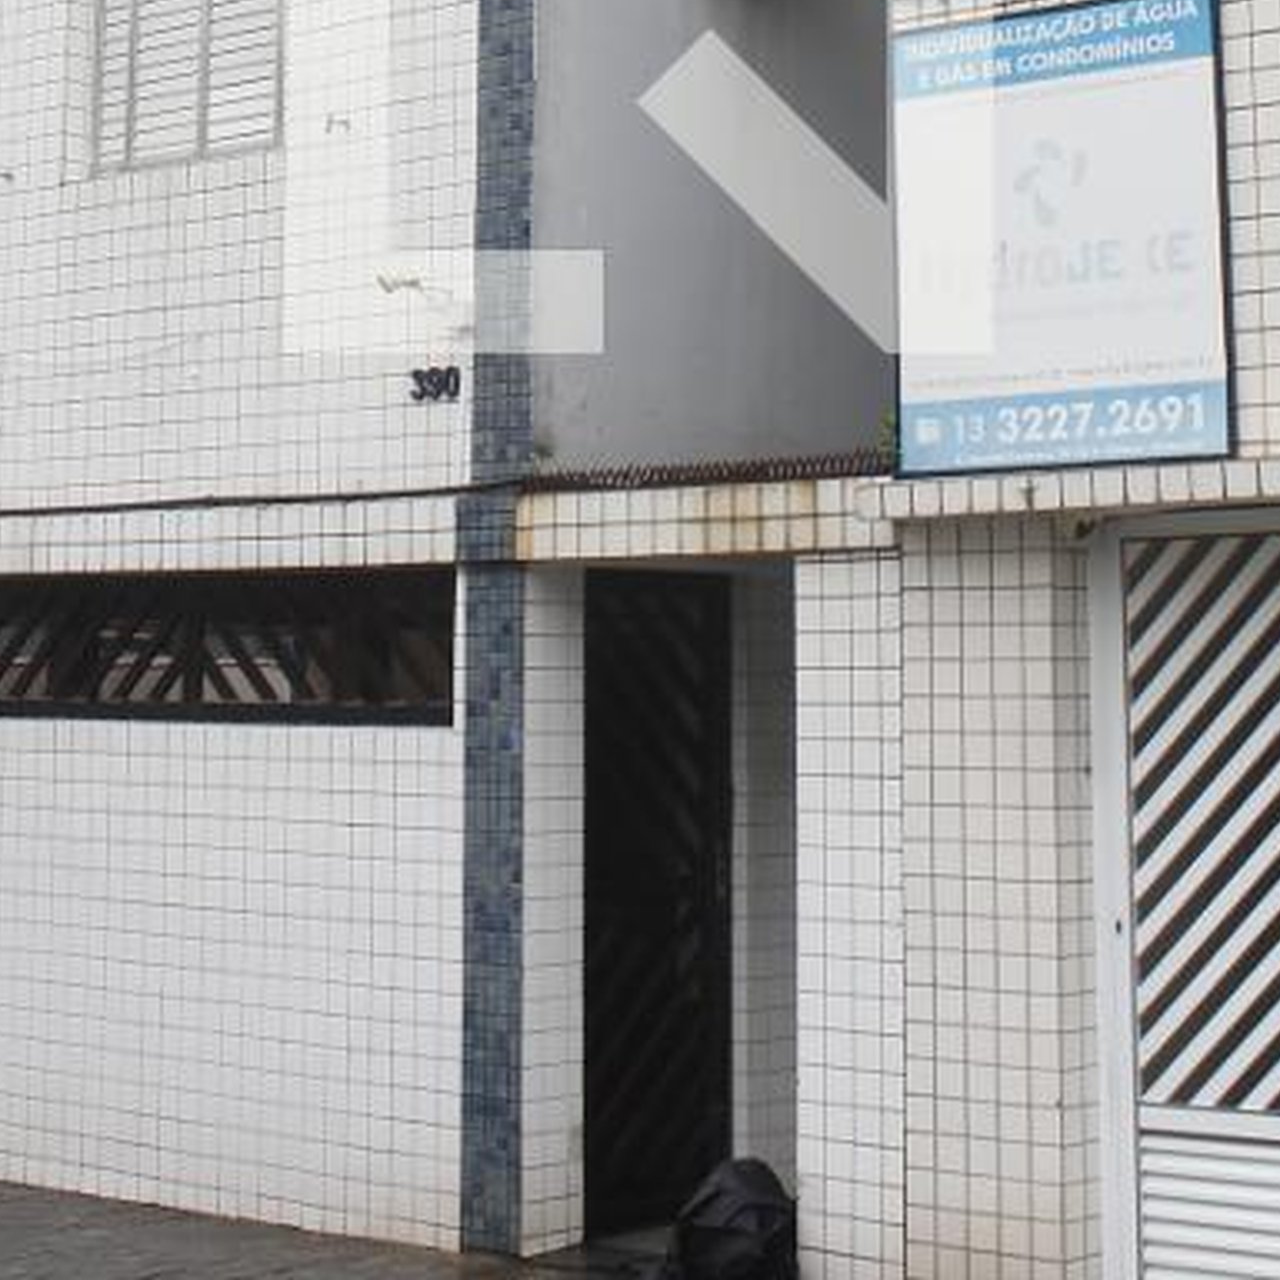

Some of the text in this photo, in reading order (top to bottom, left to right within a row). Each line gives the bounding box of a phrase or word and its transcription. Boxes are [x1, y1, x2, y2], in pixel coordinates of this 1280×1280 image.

[1102, 8, 1130, 30] DE
[1133, 0, 1199, 26] ÁGUA
[997, 393, 1205, 443] 3227.2691
